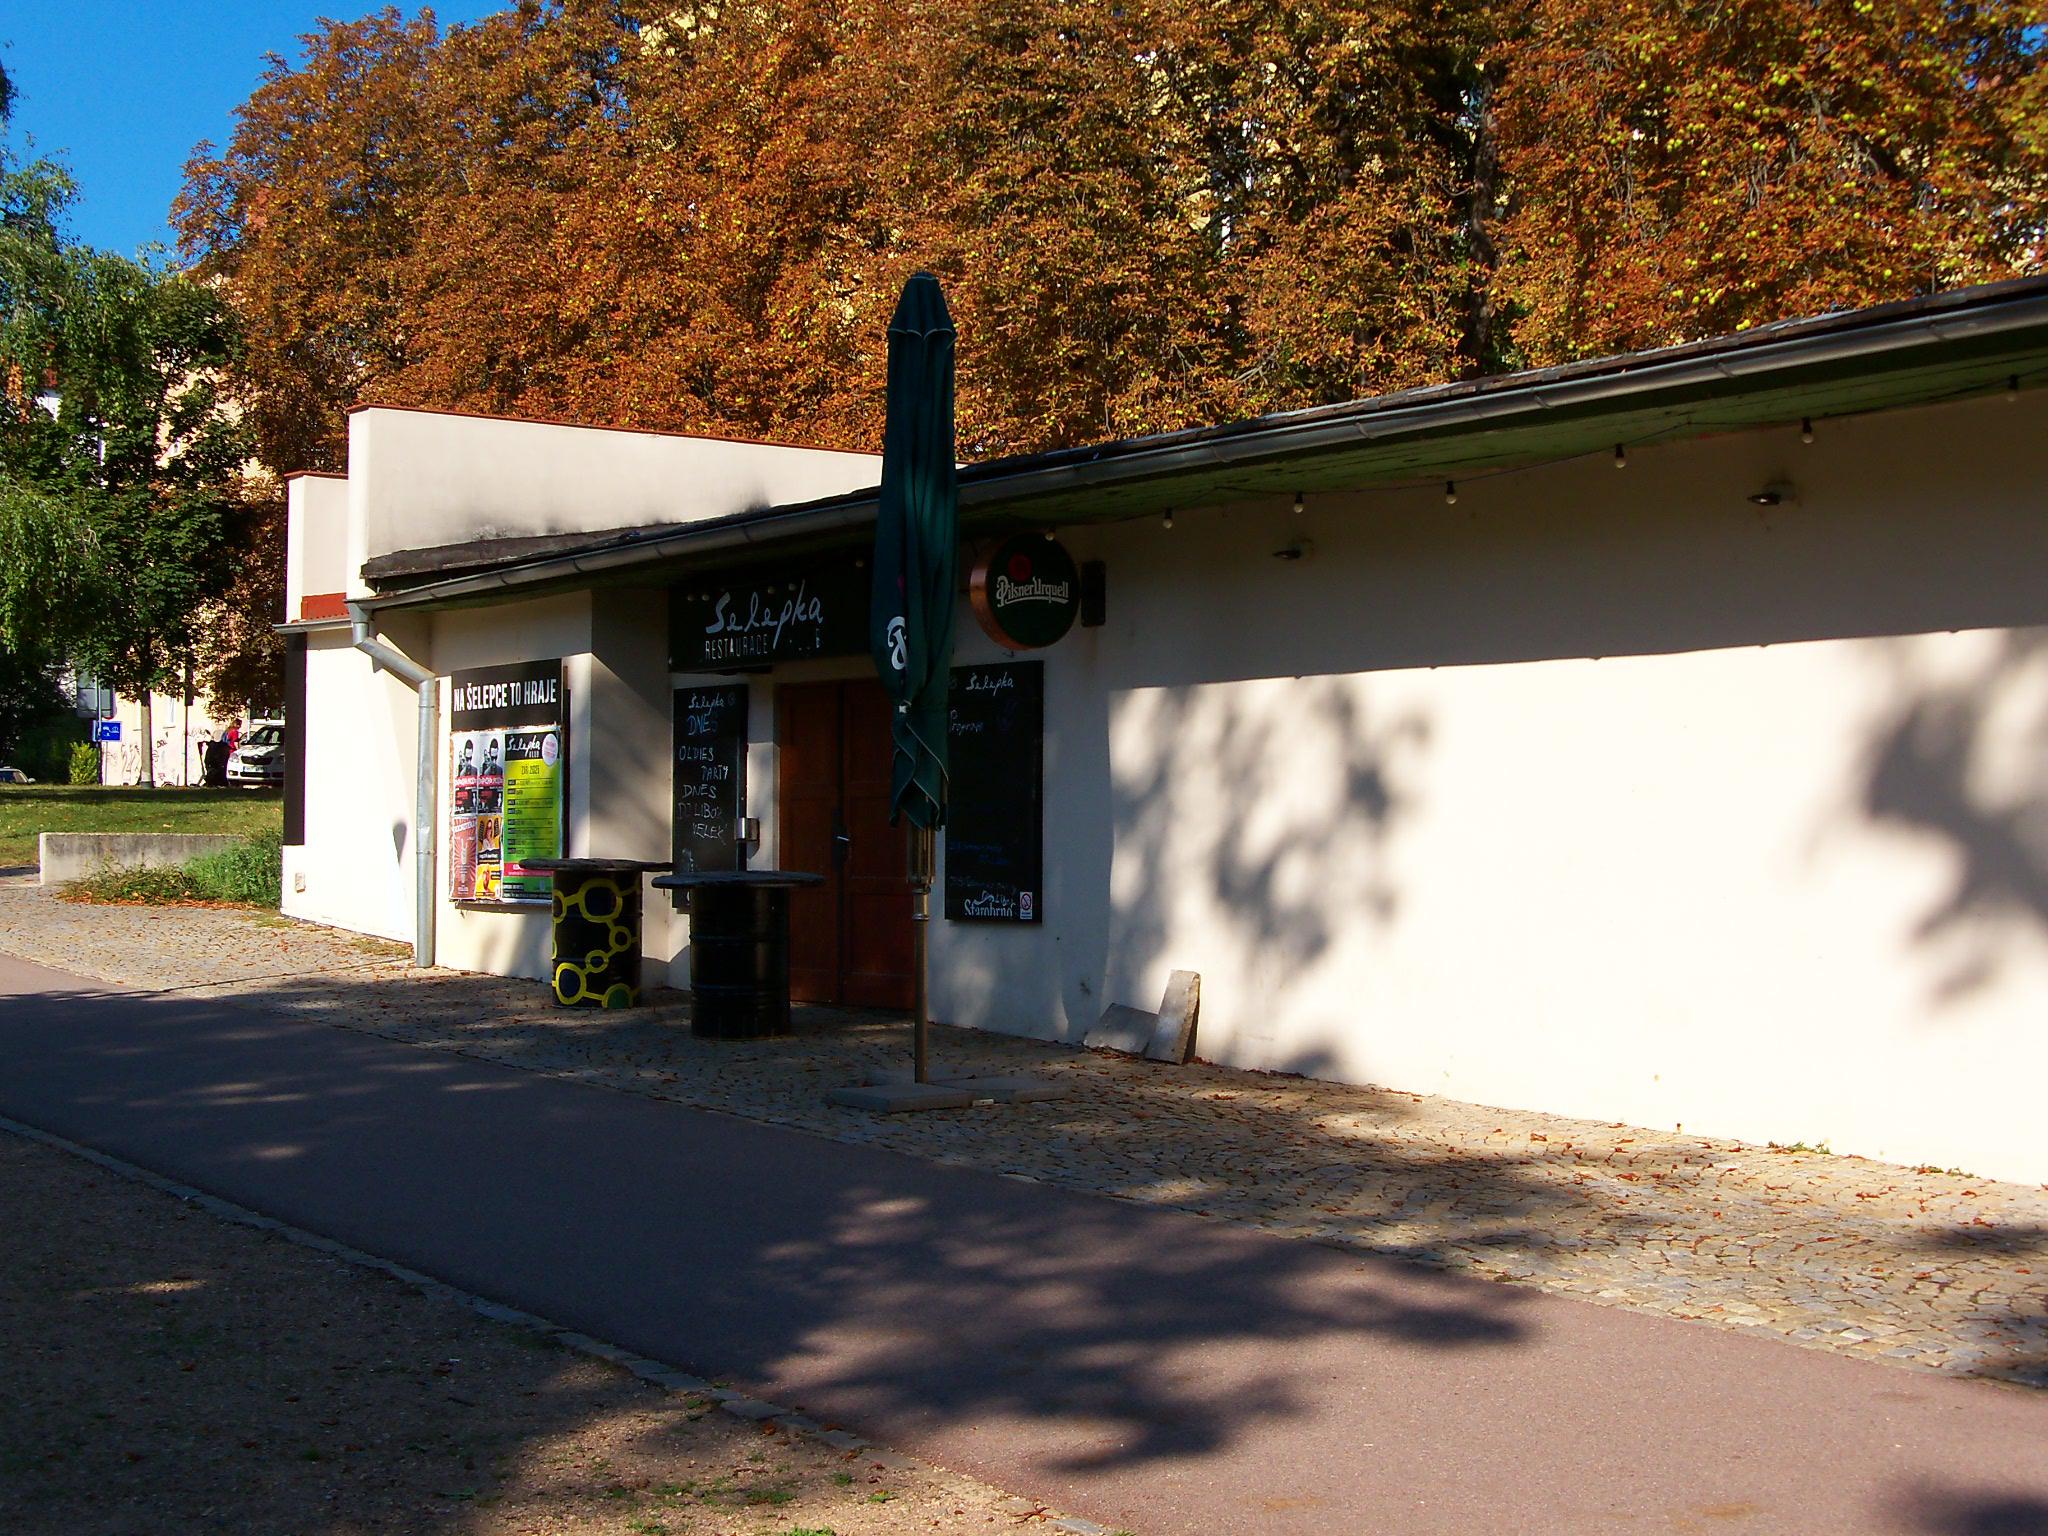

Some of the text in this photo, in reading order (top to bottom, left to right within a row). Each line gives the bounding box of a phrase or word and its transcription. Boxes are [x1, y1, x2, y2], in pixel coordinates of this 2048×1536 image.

[996, 574, 1069, 608] Pilsner Urquell
[453, 678, 557, 712] NA ŠELEPCE TO HRAJE
[701, 765, 728, 781] PARTY
[682, 783, 718, 799] DNES
